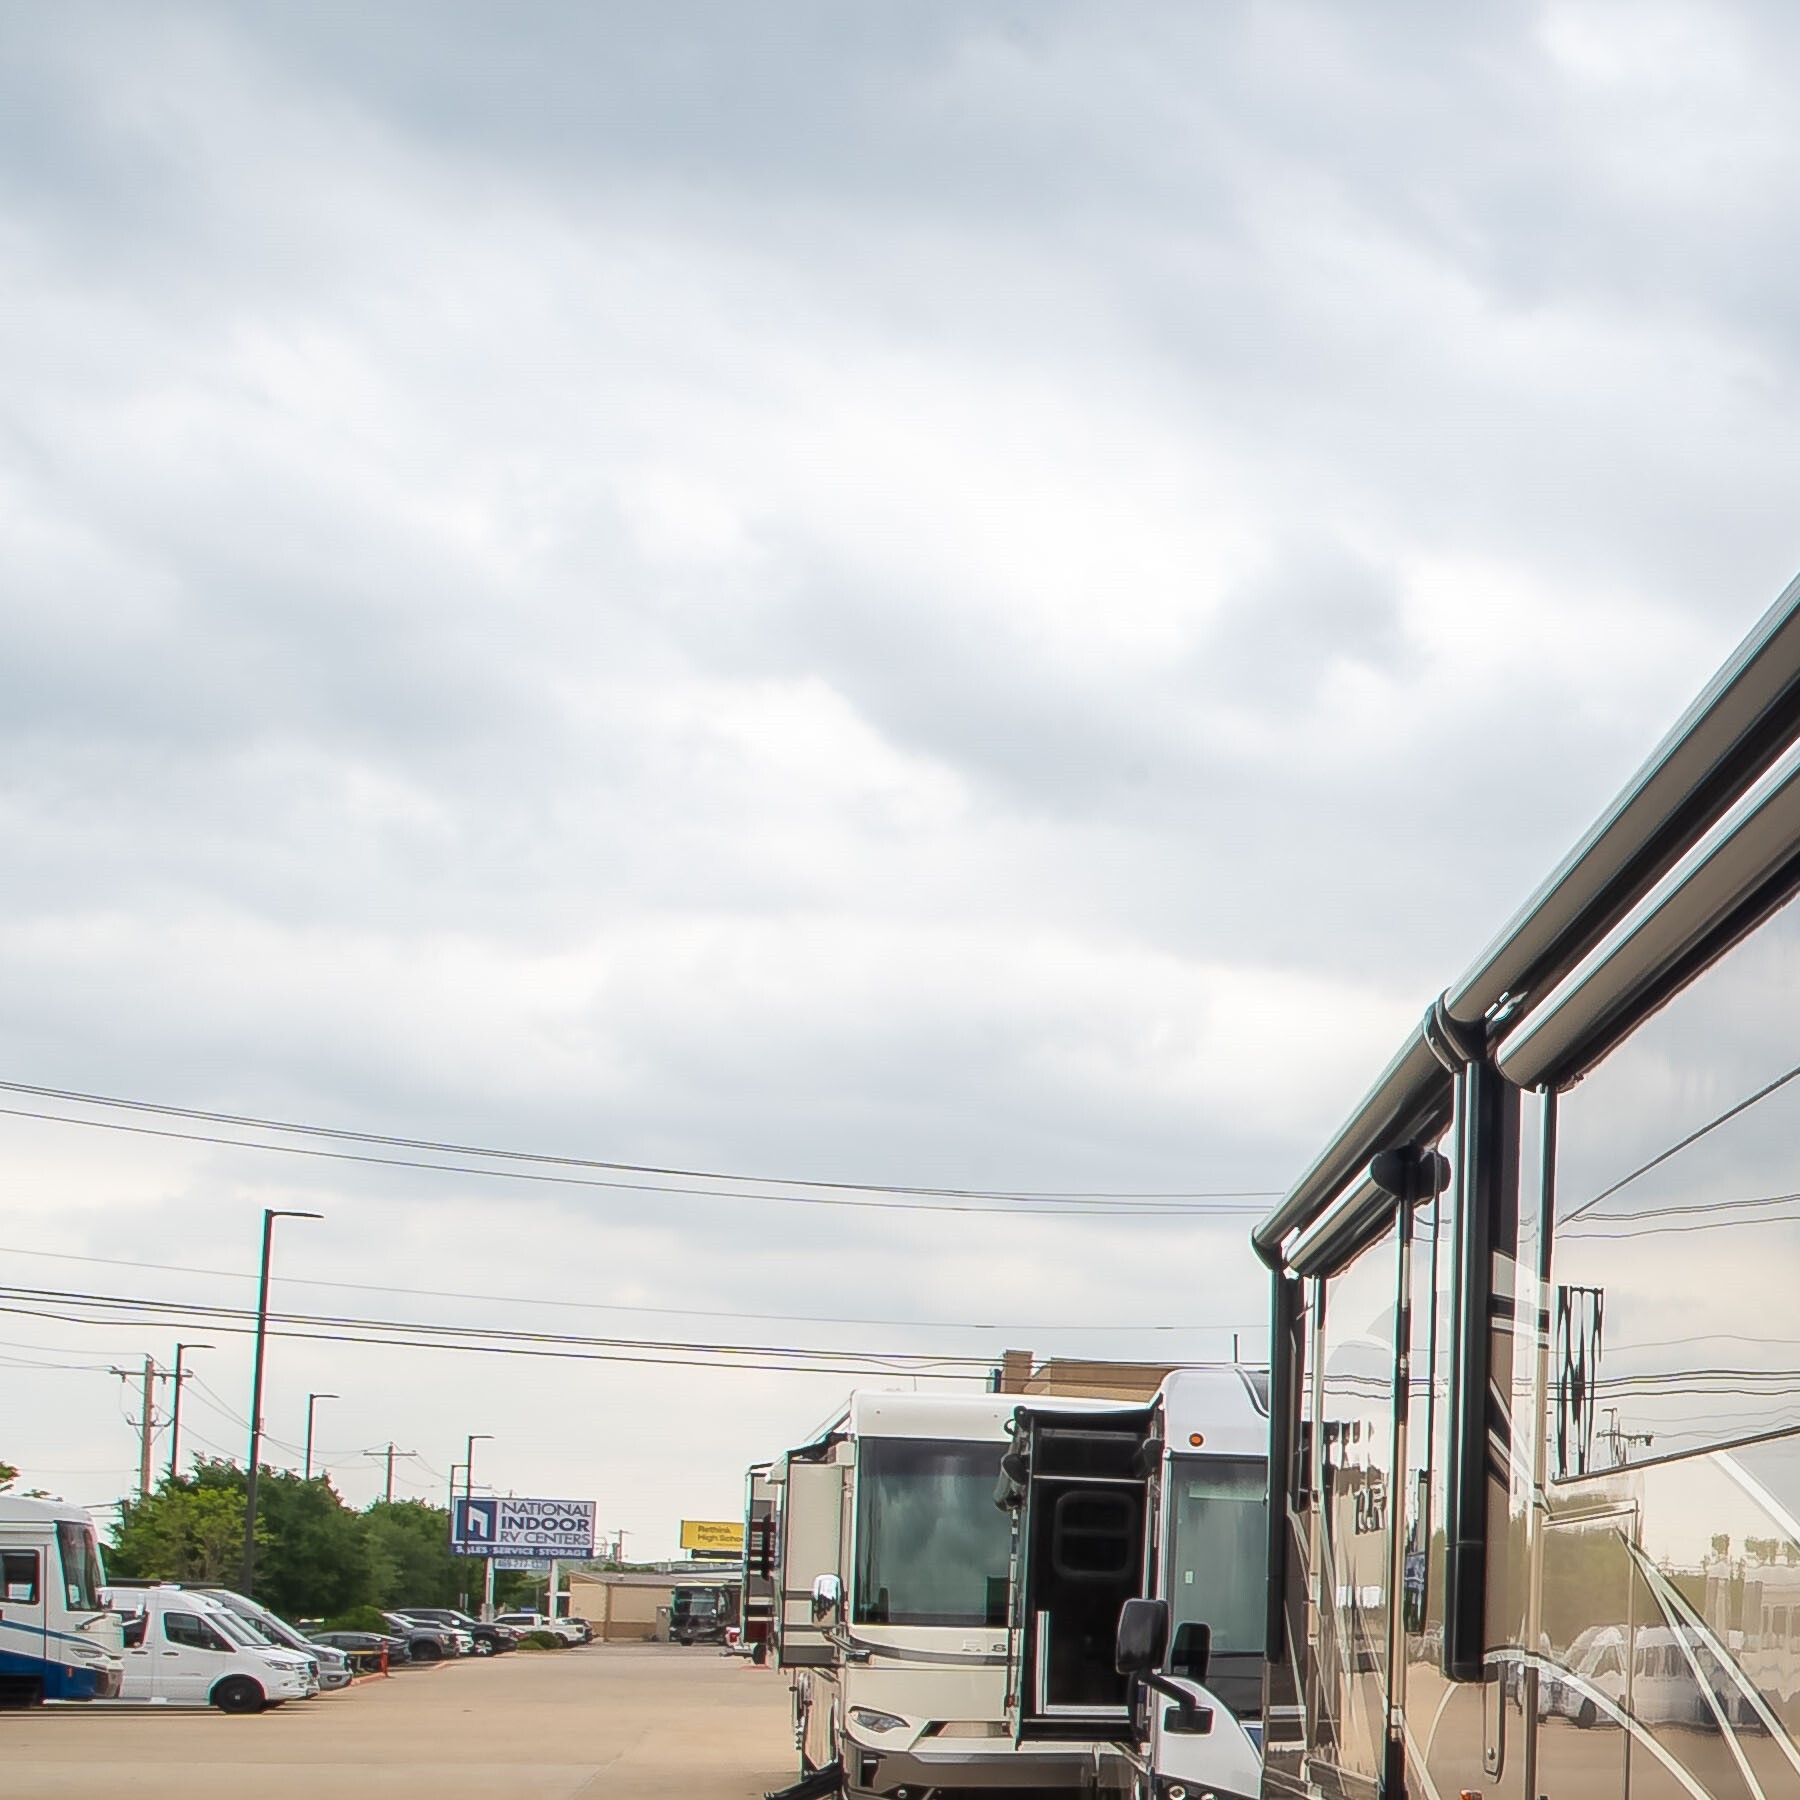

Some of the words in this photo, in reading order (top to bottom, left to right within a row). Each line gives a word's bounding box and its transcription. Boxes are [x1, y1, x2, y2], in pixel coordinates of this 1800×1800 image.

[501, 1502, 591, 1518] NATIONAL
[501, 1517, 590, 1532] INDOOR
[500, 1531, 521, 1543] RV
[524, 1532, 591, 1545] CENTERS
[492, 1546, 534, 1556] SERVICE
[539, 1548, 588, 1557] STORAGE
